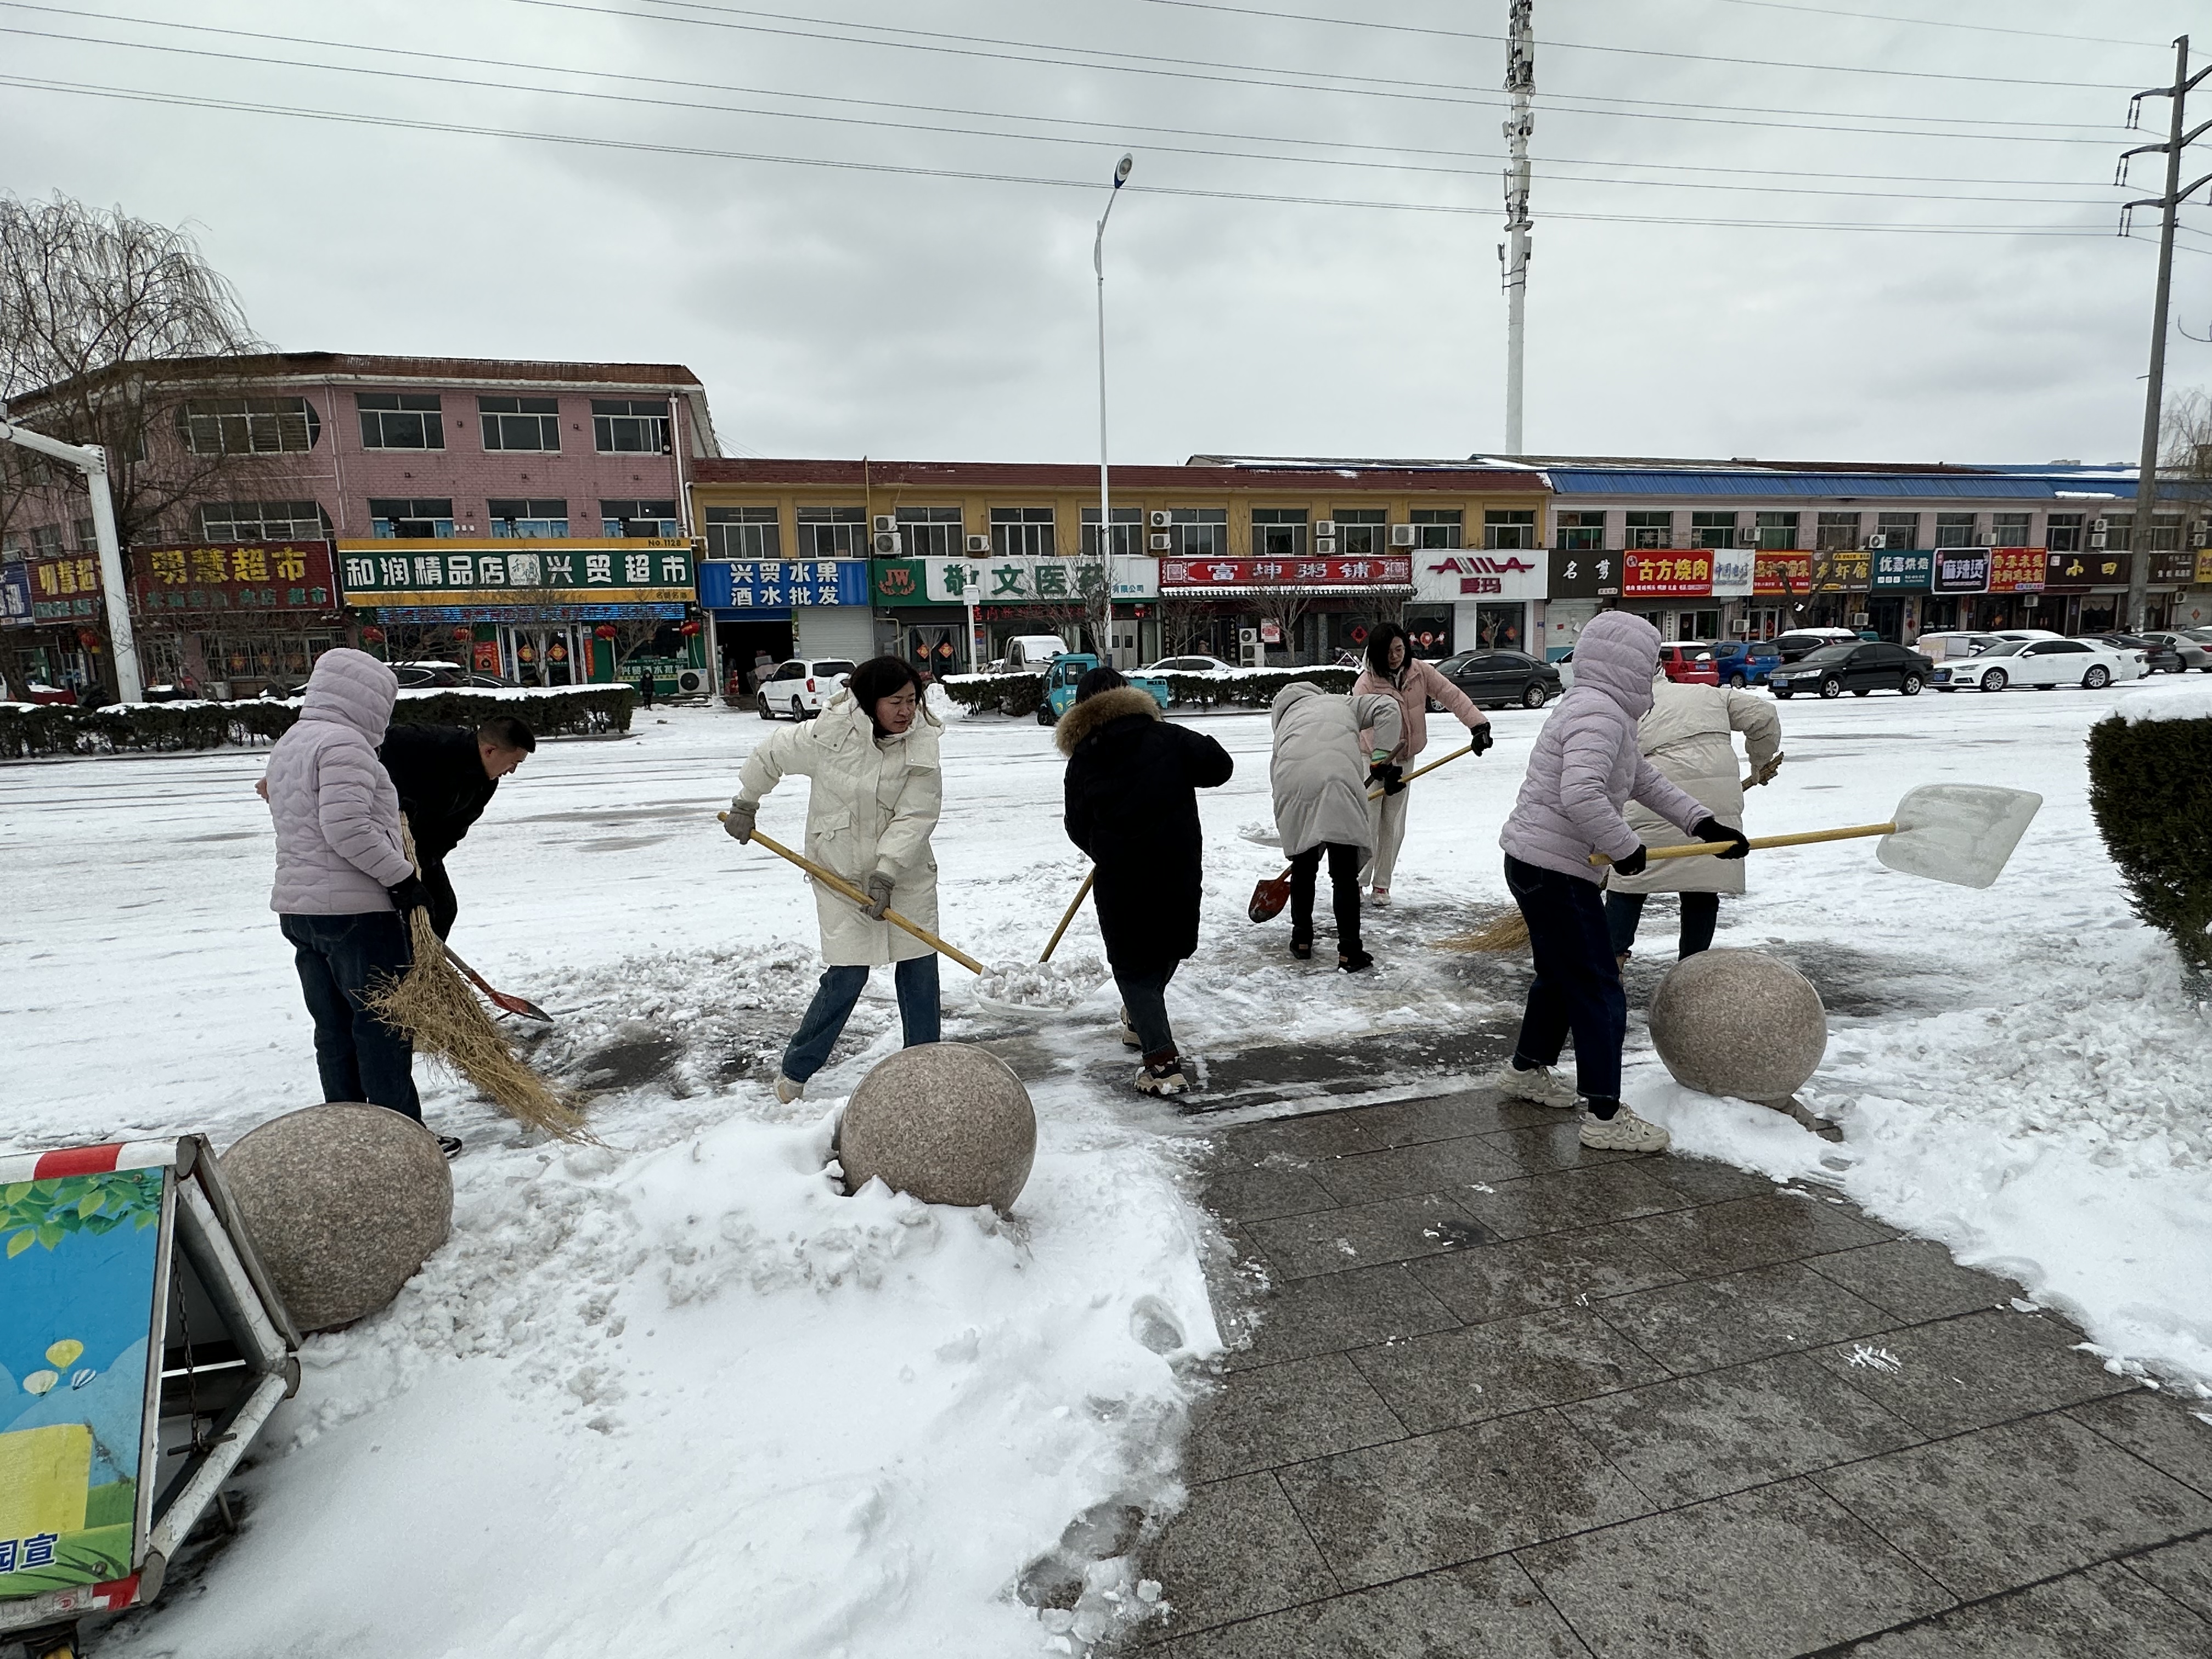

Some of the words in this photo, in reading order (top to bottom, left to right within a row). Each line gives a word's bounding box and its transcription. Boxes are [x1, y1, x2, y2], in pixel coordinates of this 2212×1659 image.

[151, 546, 307, 584] 明慧超市
[346, 555, 505, 586] 和润精品店
[546, 554, 686, 584] 兴贸超市
[730, 561, 839, 584] 兴贸水果
[1207, 562, 1371, 581] 富坤粥铺
[1638, 558, 1708, 581] 古方烧肉
[38, 558, 104, 596] 明慧超
[885, 569, 911, 586] JW
[1460, 577, 1502, 594] 爱玛
[731, 586, 839, 606] 酒水批发
